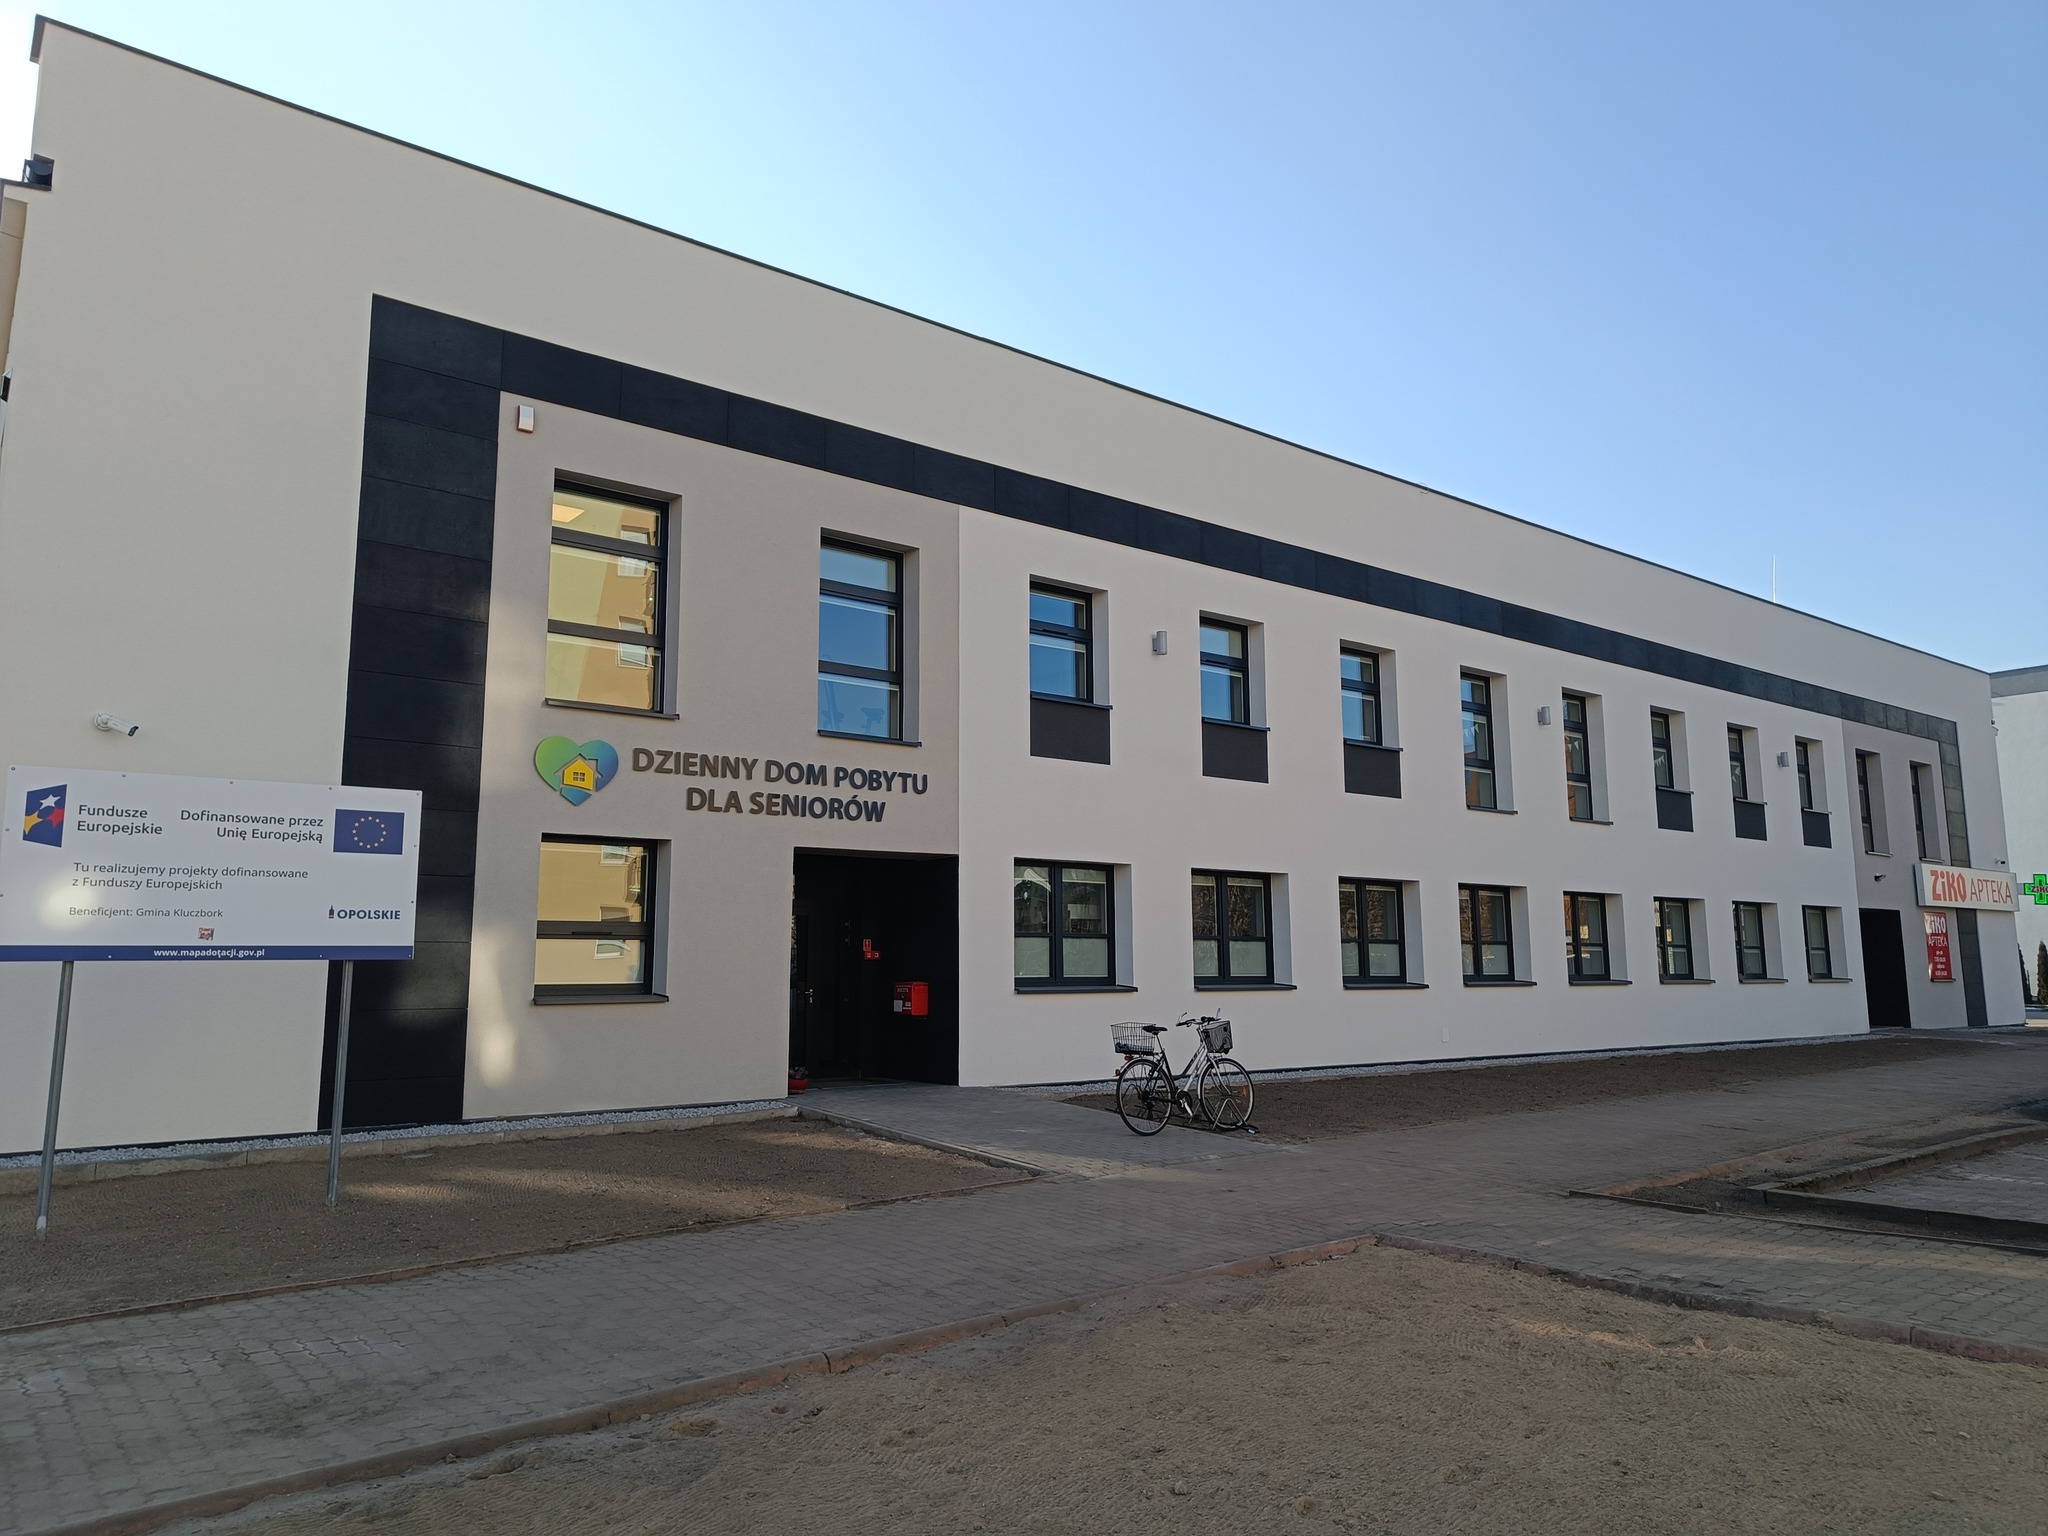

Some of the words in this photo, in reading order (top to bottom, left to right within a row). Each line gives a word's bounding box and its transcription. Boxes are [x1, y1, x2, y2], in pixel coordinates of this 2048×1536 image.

[632, 747, 759, 780] DZIENNY
[764, 759, 828, 786] DOM
[834, 766, 928, 794] POBYTU
[78, 804, 148, 818] Fundusze
[686, 787, 743, 814] DLA
[748, 792, 886, 822] SENIORÓW
[180, 809, 285, 825] Dofinansowane
[288, 817, 324, 828] przez
[77, 820, 163, 836] Europejskie
[216, 827, 247, 841] Unię
[251, 828, 323, 844] Europejską
[73, 862, 90, 873] Tu
[93, 863, 166, 877] realizujemy
[168, 865, 218, 878] projekty
[221, 866, 309, 878] dofinansowane
[72, 878, 79, 887] z
[82, 877, 143, 891] Funduszy
[146, 878, 223, 892] Europejskich
[1970, 878, 2013, 904] APTEKA
[69, 906, 133, 919] Beneficjent:
[135, 907, 171, 918] Gmina
[173, 908, 224, 919] Kluczbork
[337, 909, 401, 920] OPOLSKIE
[1928, 935, 1948, 947] APTEKA
[153, 948, 265, 958] www.mapadotacji.gov.pl
